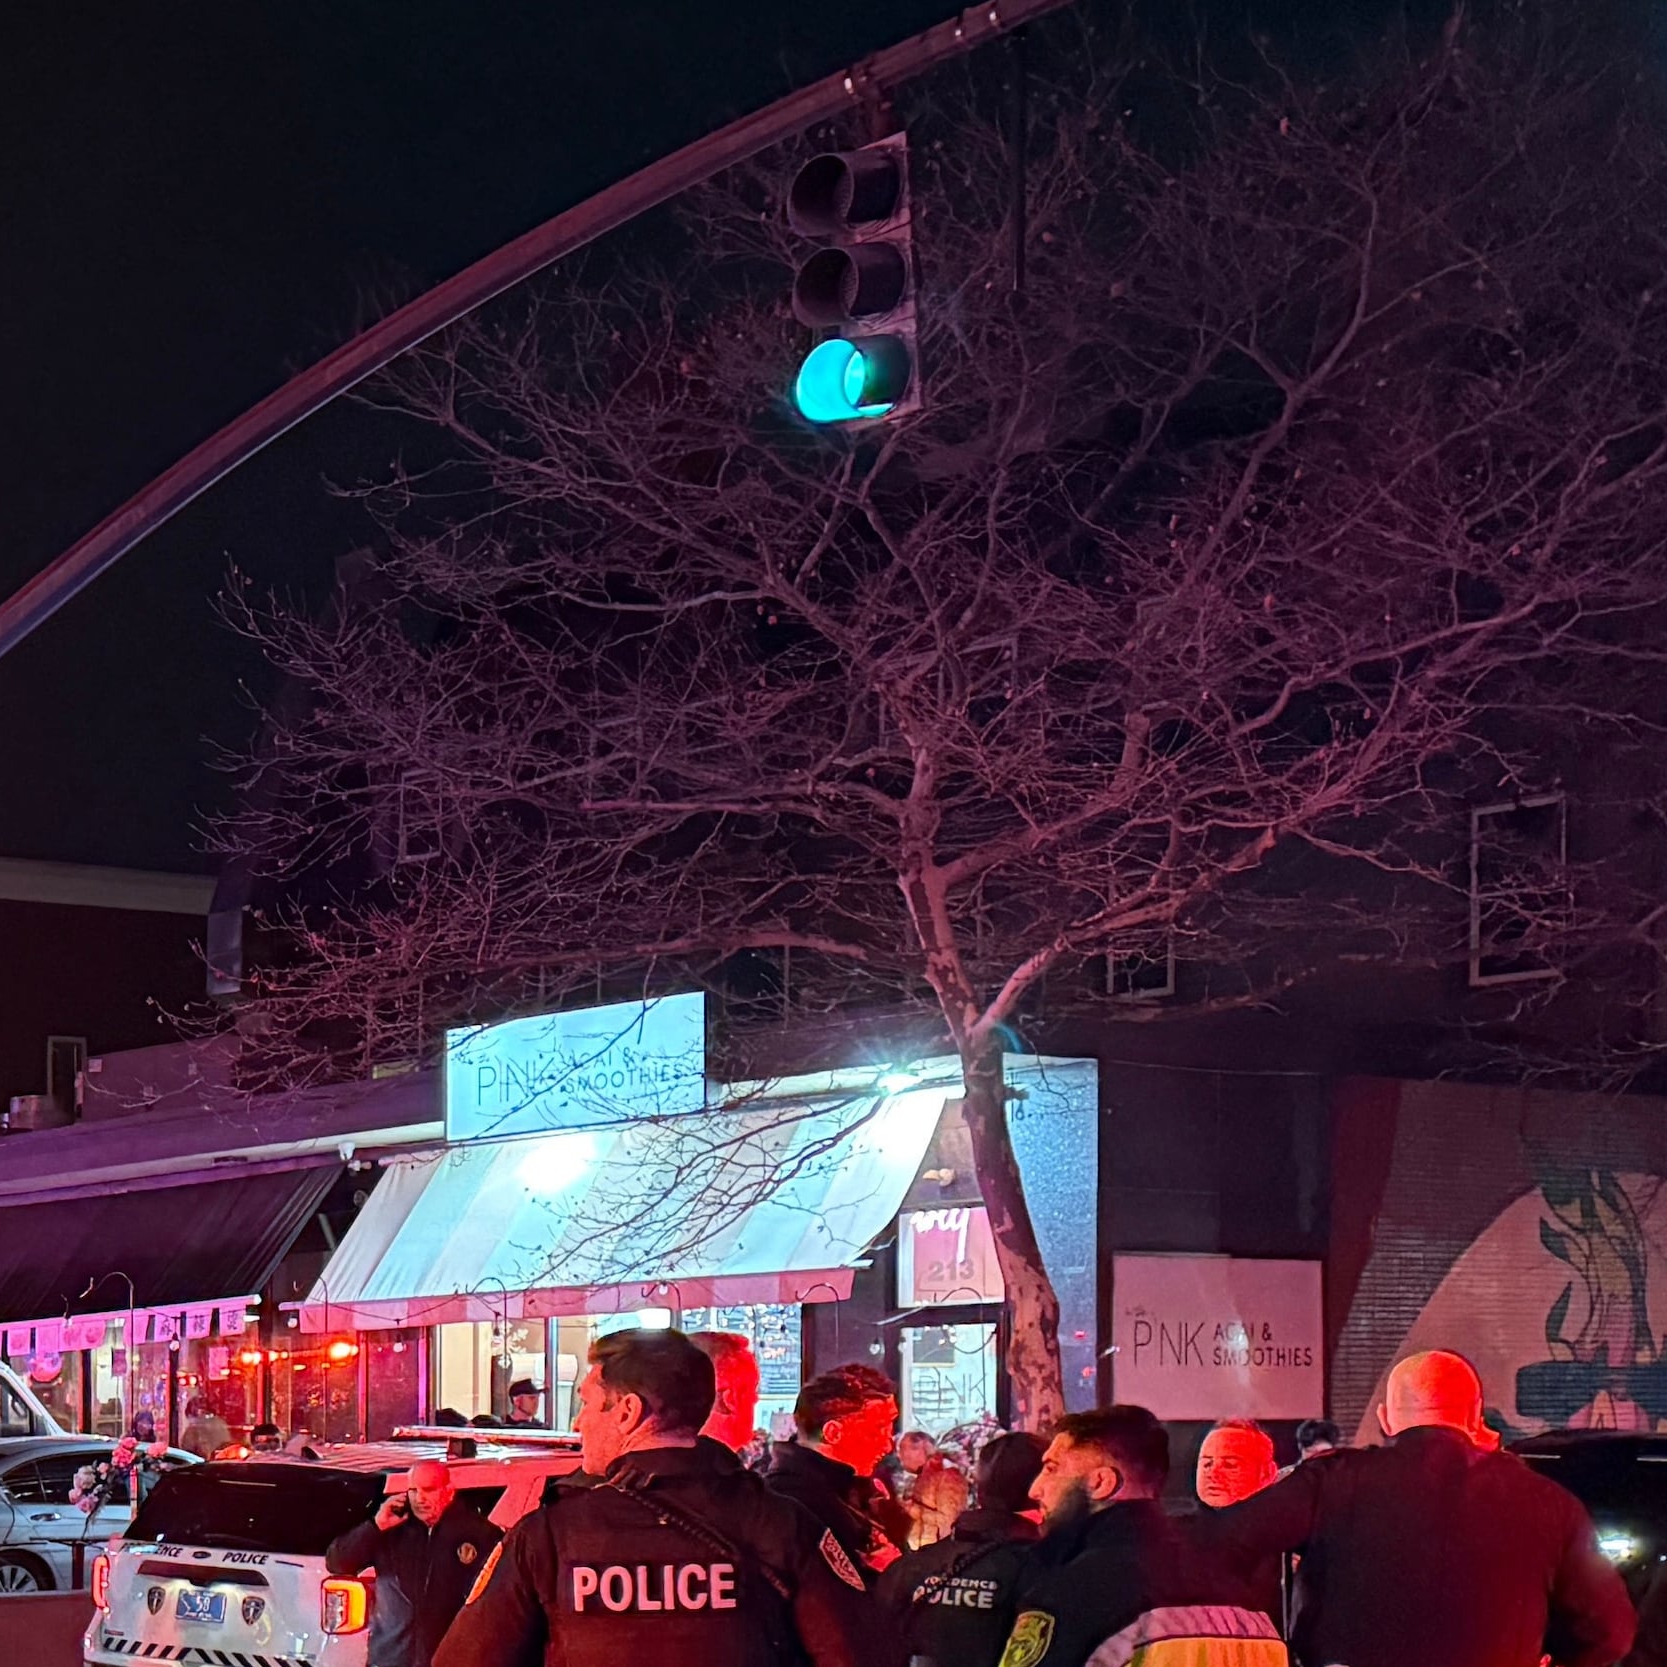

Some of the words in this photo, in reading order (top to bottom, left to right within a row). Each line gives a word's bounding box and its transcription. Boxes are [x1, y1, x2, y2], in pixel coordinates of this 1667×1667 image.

[566, 1064, 684, 1093] SMOOTHIES
[928, 1259, 974, 1281] 213
[1134, 1320, 1205, 1366] PNK
[1261, 1323, 1273, 1341] &
[1214, 1347, 1313, 1367] SMOOTHIES
[222, 1552, 269, 1565] POLICE
[573, 1563, 736, 1612] POLICE
